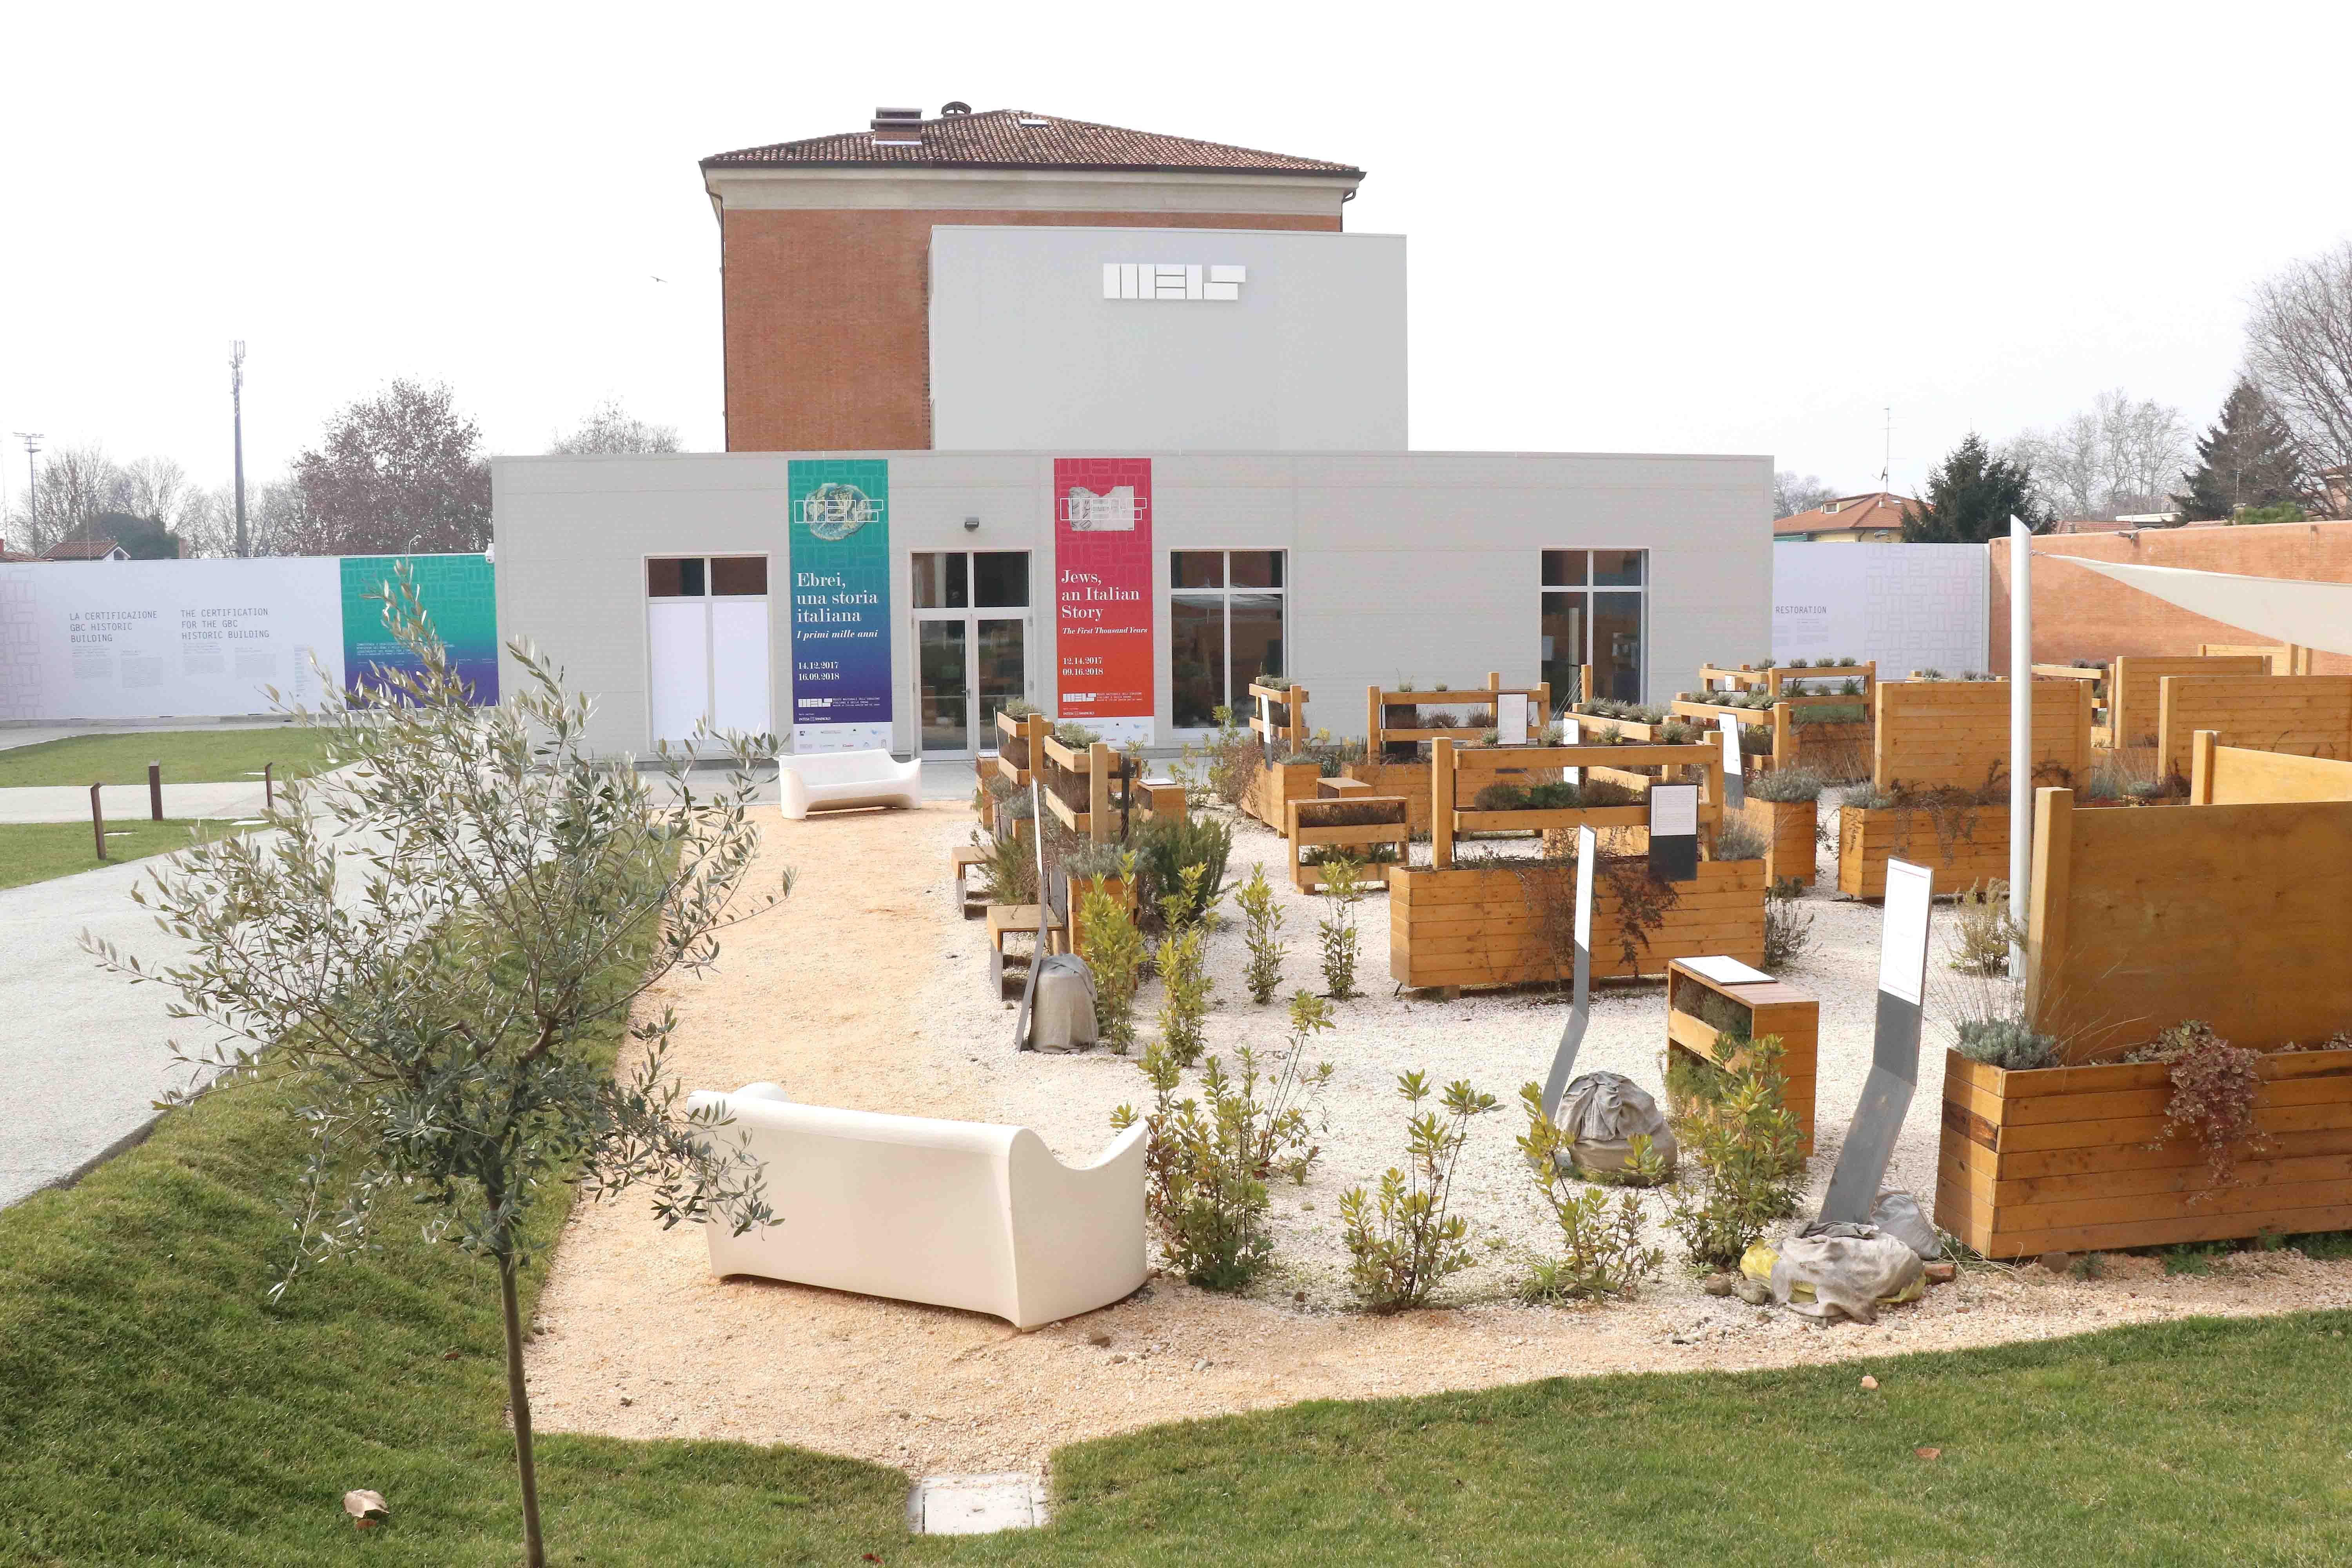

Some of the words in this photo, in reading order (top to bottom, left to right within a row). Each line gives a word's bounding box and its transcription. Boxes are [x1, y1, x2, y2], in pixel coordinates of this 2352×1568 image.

[797, 572, 846, 589] Ebrei,
[1061, 570, 1102, 586] Jews,
[797, 595, 827, 604] una
[832, 590, 878, 604] storia
[1062, 591, 1081, 601] an
[1085, 586, 1140, 601] Italian
[85, 611, 157, 620] CERTIFICAZIONE
[181, 609, 195, 617] THE
[201, 608, 268, 617] CERTIFICATION
[797, 608, 862, 622] italiana
[1062, 605, 1104, 622] Story
[71, 634, 113, 642] BUILDING
[182, 631, 223, 640] HISTORIC
[228, 630, 269, 639] BUILDING
[803, 630, 829, 641] primi
[799, 661, 838, 670] 14.12.2017
[1063, 657, 1103, 665] 12.14.2017
[799, 673, 840, 681] 16.09.2018
[1063, 668, 1103, 676] 09.16.2018
